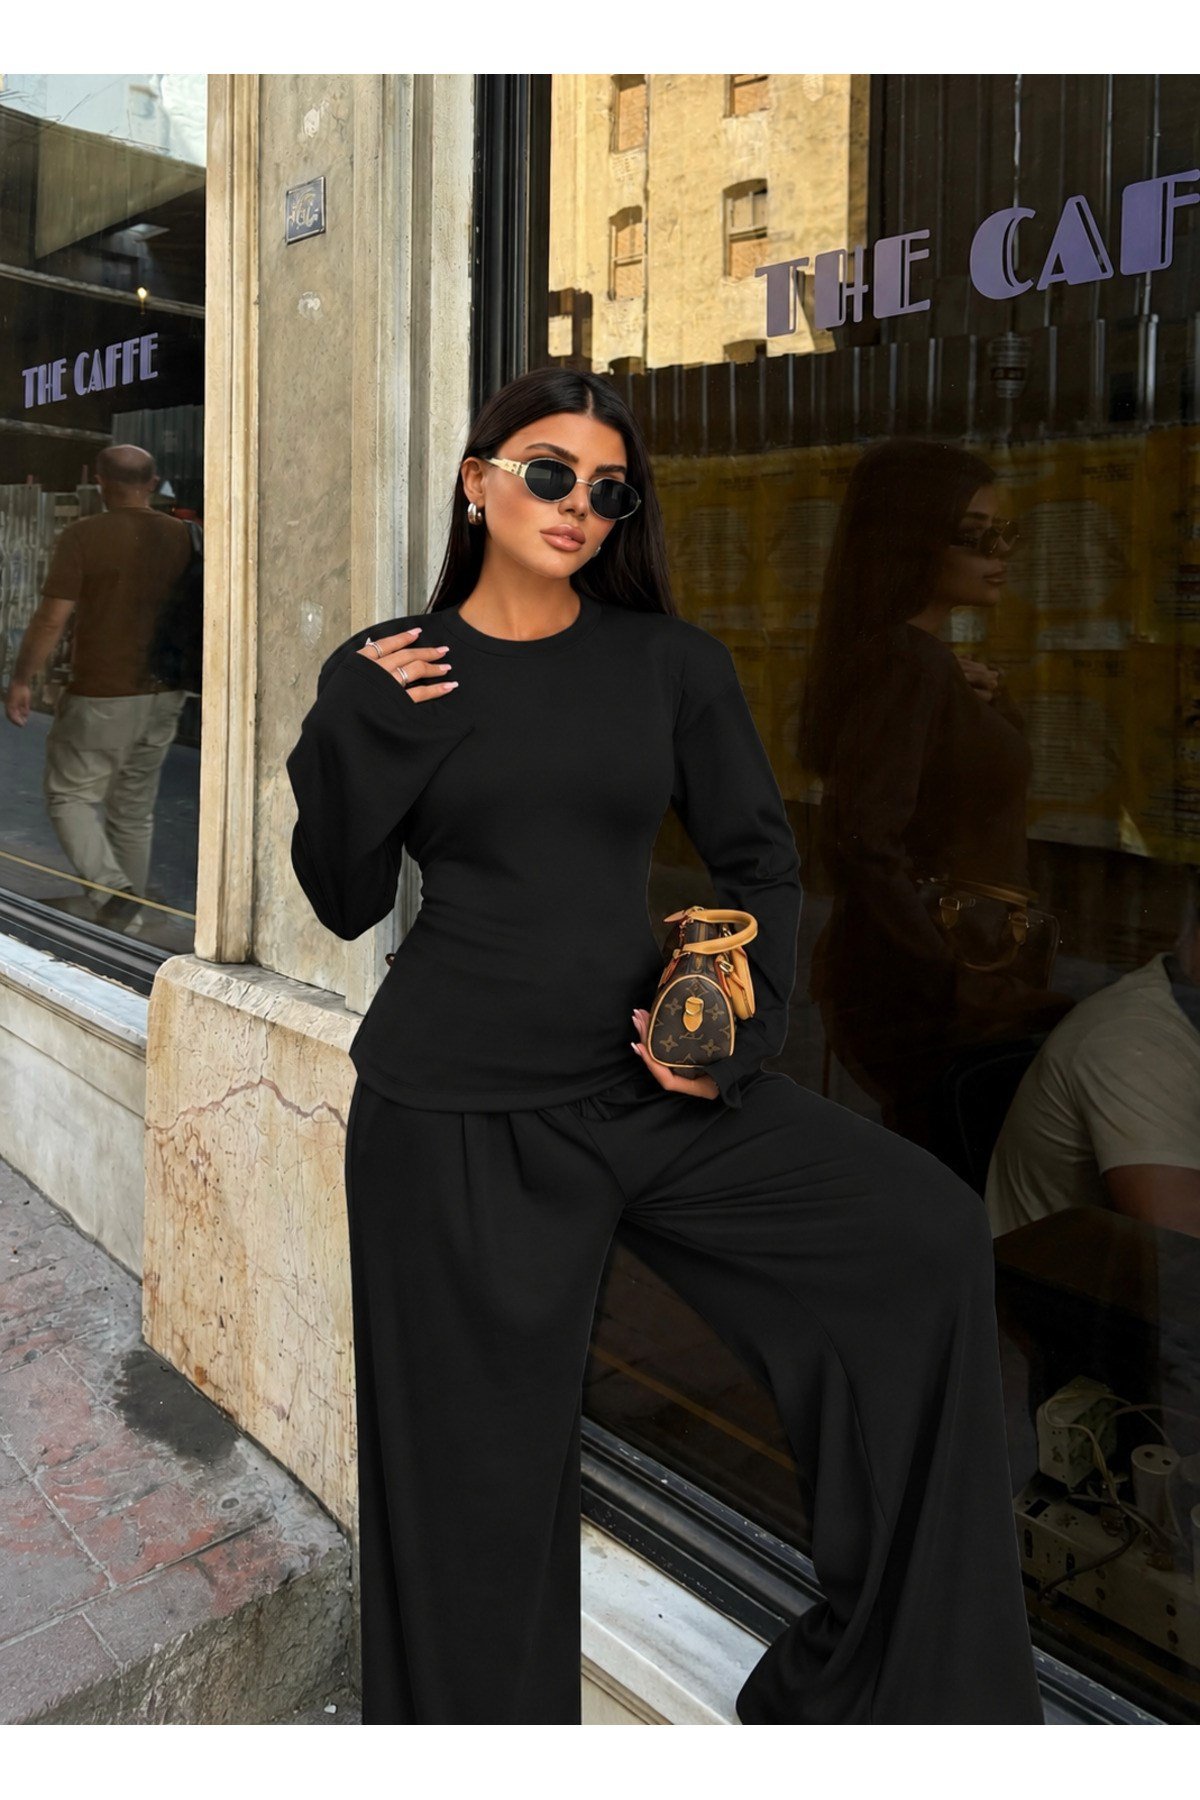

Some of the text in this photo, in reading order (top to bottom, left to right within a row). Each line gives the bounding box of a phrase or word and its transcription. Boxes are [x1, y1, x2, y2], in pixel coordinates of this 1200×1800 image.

[755, 169, 1200, 338] THE CAF
[22, 332, 159, 409] THE CAFFE
